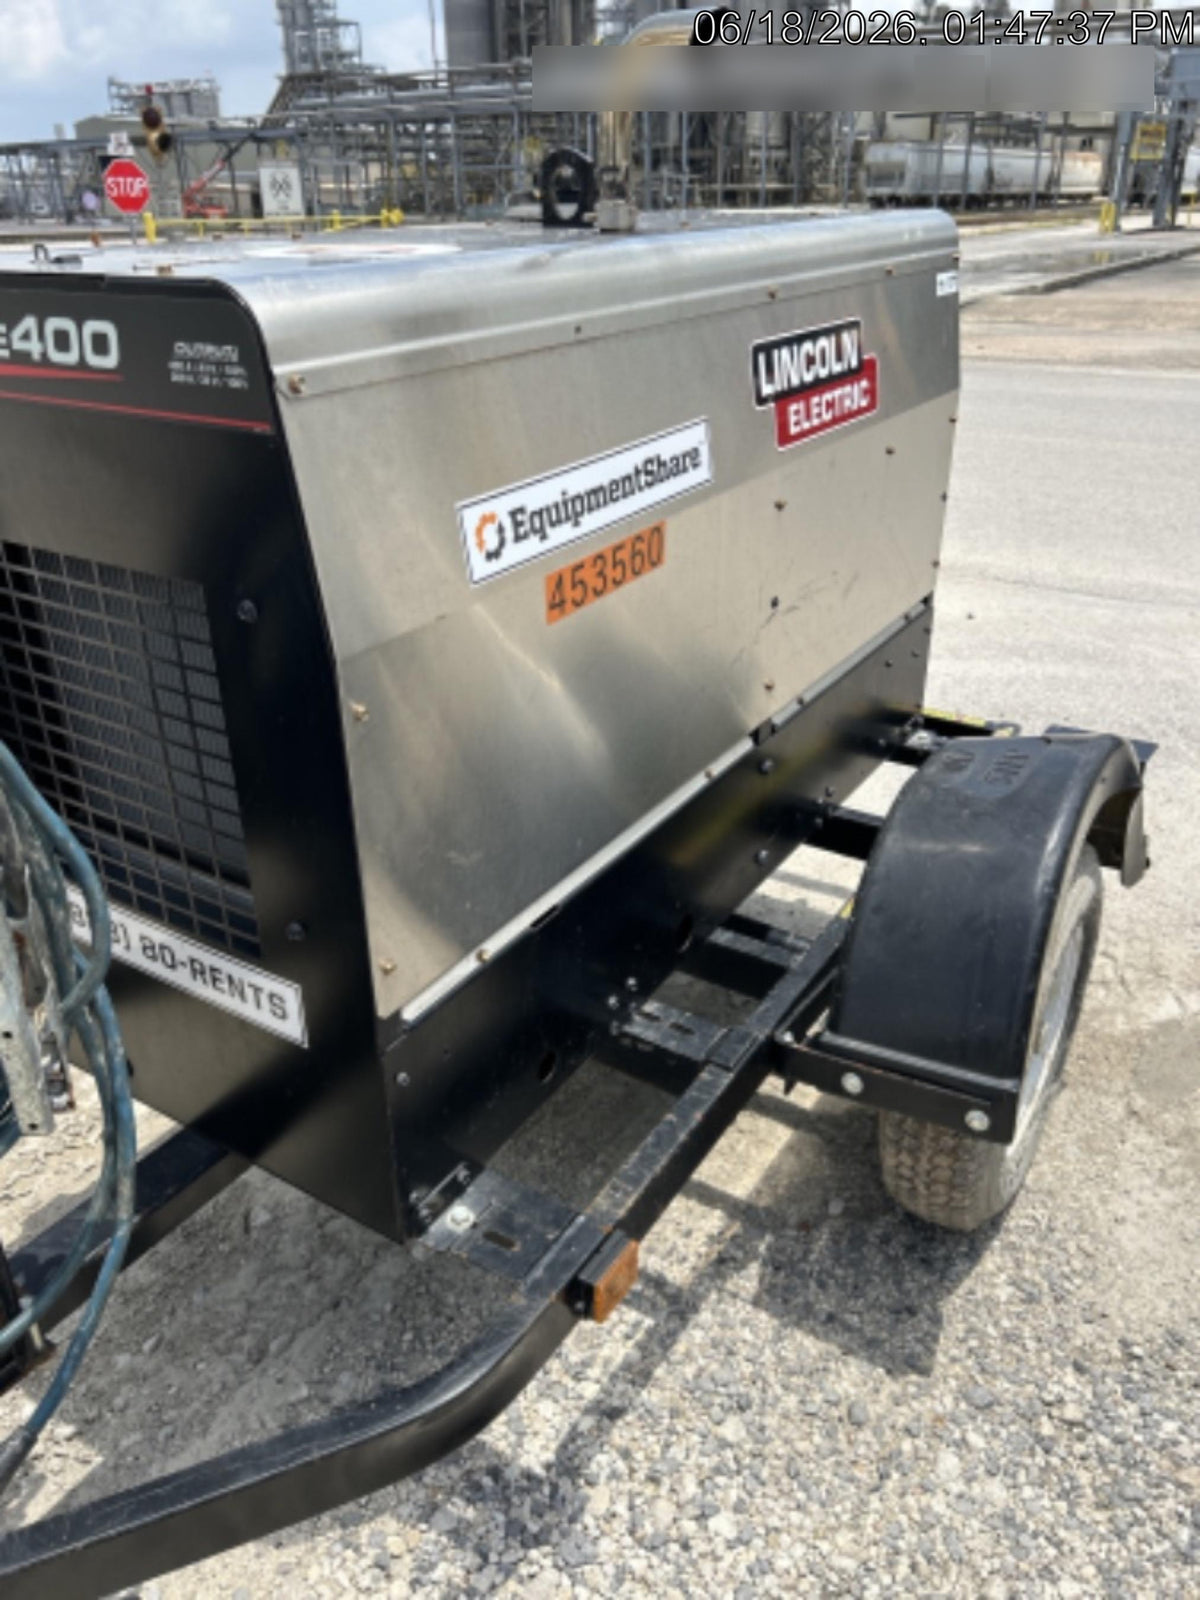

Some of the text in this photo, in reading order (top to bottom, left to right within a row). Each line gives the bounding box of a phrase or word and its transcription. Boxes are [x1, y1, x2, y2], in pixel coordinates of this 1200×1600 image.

[105, 176, 147, 198] STOP
[758, 328, 859, 398] LINCOLN
[787, 378, 870, 436] ELECTRIC
[507, 446, 701, 544] EquipmentShare
[547, 525, 664, 616] 453560
[141, 933, 288, 1021] 80-RENTS
